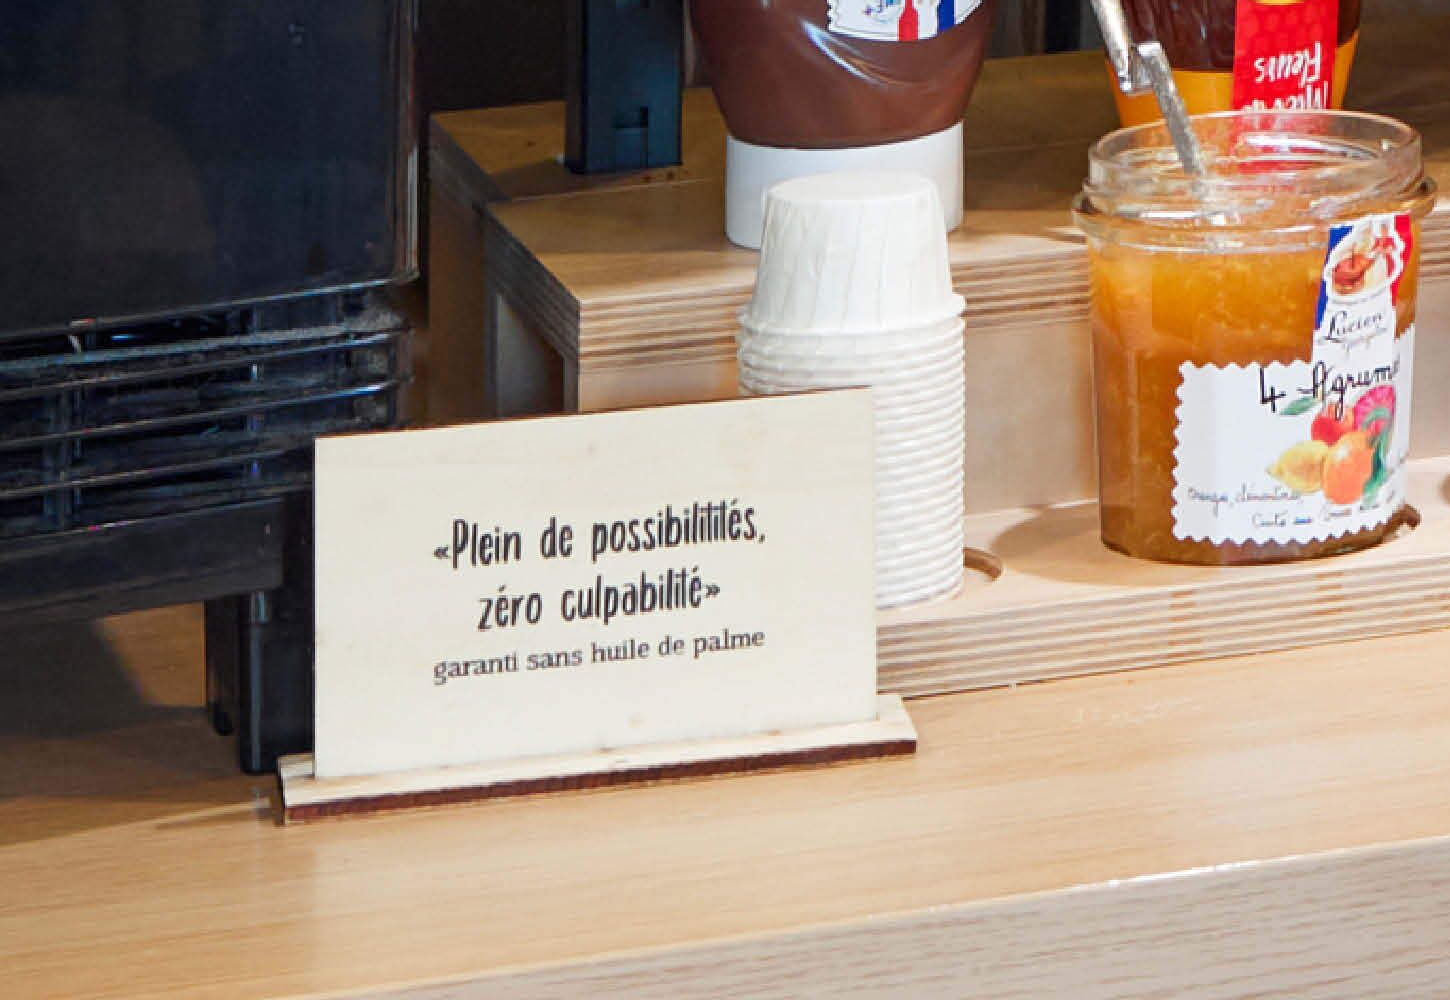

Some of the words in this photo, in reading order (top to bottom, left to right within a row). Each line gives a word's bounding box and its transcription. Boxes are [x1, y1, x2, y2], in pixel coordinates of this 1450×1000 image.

[1254, 42, 1322, 88] Fleurs
[1259, 366, 1287, 414] 4
[433, 517, 522, 570] «Plein
[540, 515, 573, 560] de
[476, 584, 543, 632] zéro
[560, 565, 721, 626] culpabilité»
[433, 649, 519, 686] garanti
[525, 648, 583, 672] sans
[591, 637, 650, 666] huile
[657, 632, 686, 659] de
[692, 626, 767, 661] palme
